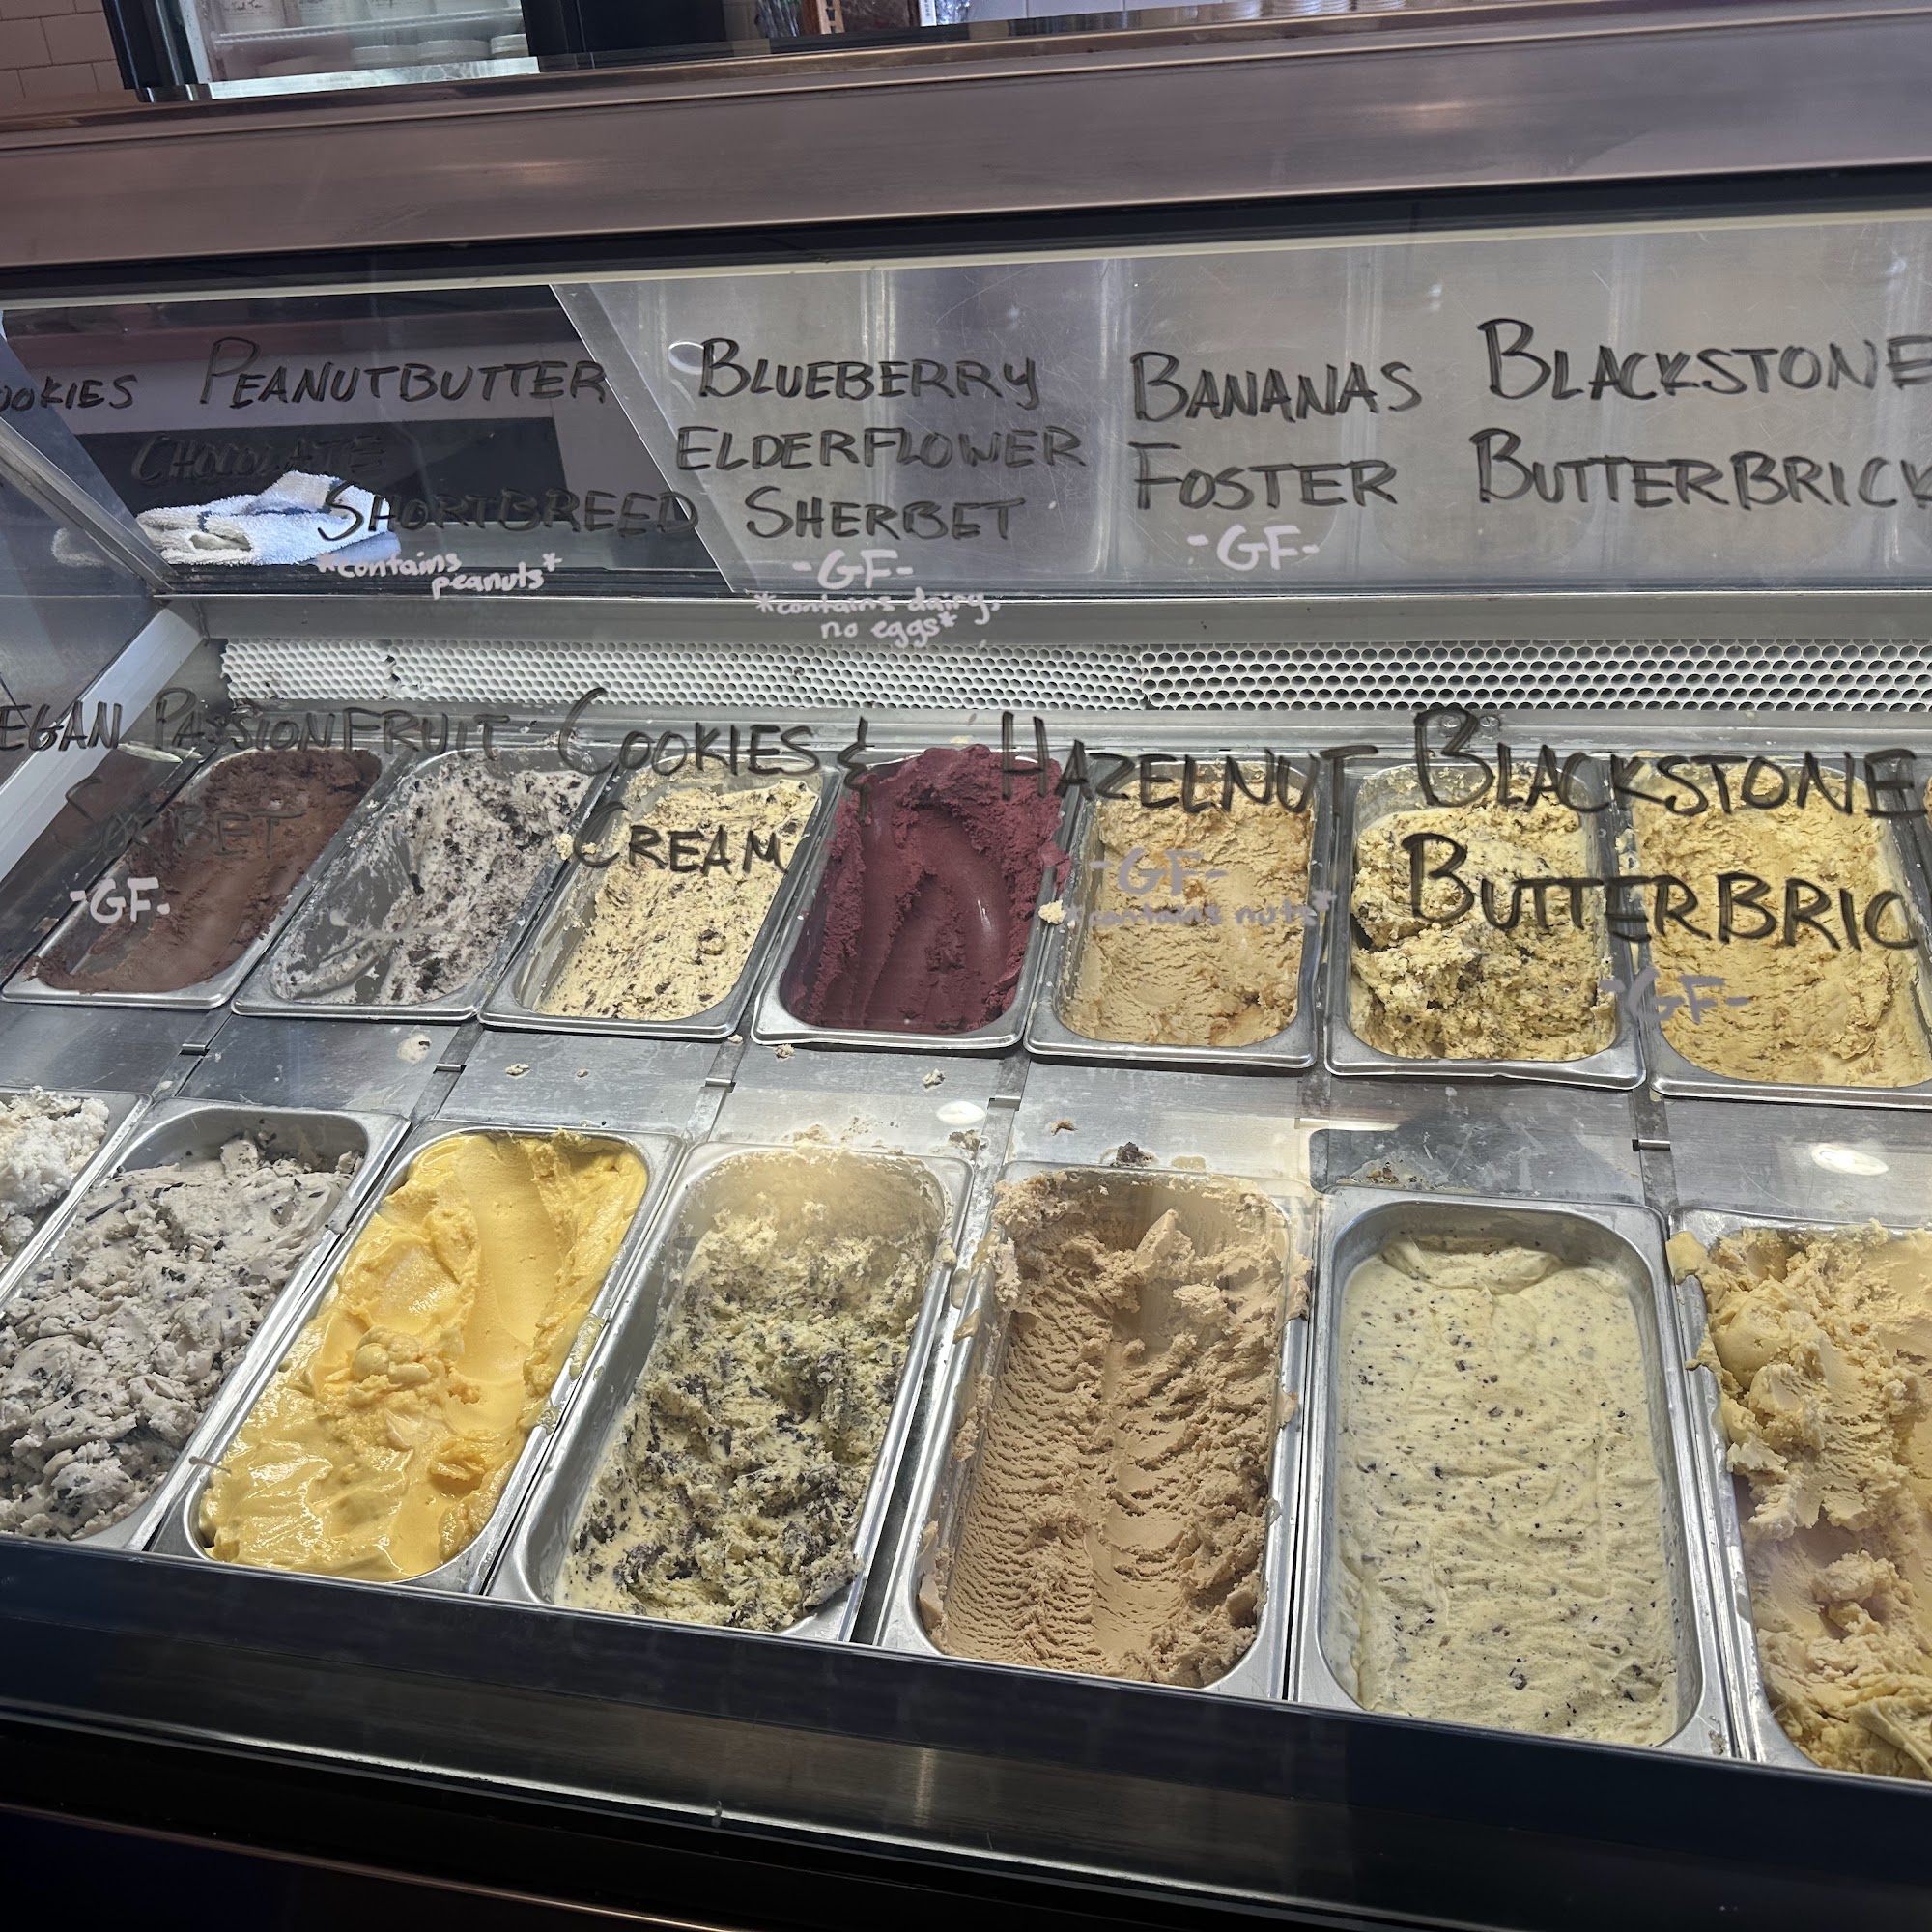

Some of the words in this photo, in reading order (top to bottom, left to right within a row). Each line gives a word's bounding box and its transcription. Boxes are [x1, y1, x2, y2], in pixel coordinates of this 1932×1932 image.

[198, 337, 607, 409] PEANUTBUTTER
[698, 337, 1037, 411] BLUEBERRY
[1129, 351, 1422, 423] BANANAS
[1478, 317, 1932, 401] BLACKSTONE
[131, 434, 388, 482] CHOCOLATE
[678, 425, 1086, 471] ELDERFLOWER
[1128, 440, 1398, 510] FOSTER
[317, 480, 697, 540] SHORTBREED
[746, 485, 1025, 539] SHERBET
[792, 549, 914, 590] -GF-
[1186, 525, 1320, 571] -GF-
[821, 620, 859, 639] no
[557, 686, 819, 776] COOKIES
[1000, 710, 1379, 815] HAZELNUT
[1413, 706, 1927, 818] BLACKSTONE
[573, 801, 790, 875] CREAM
